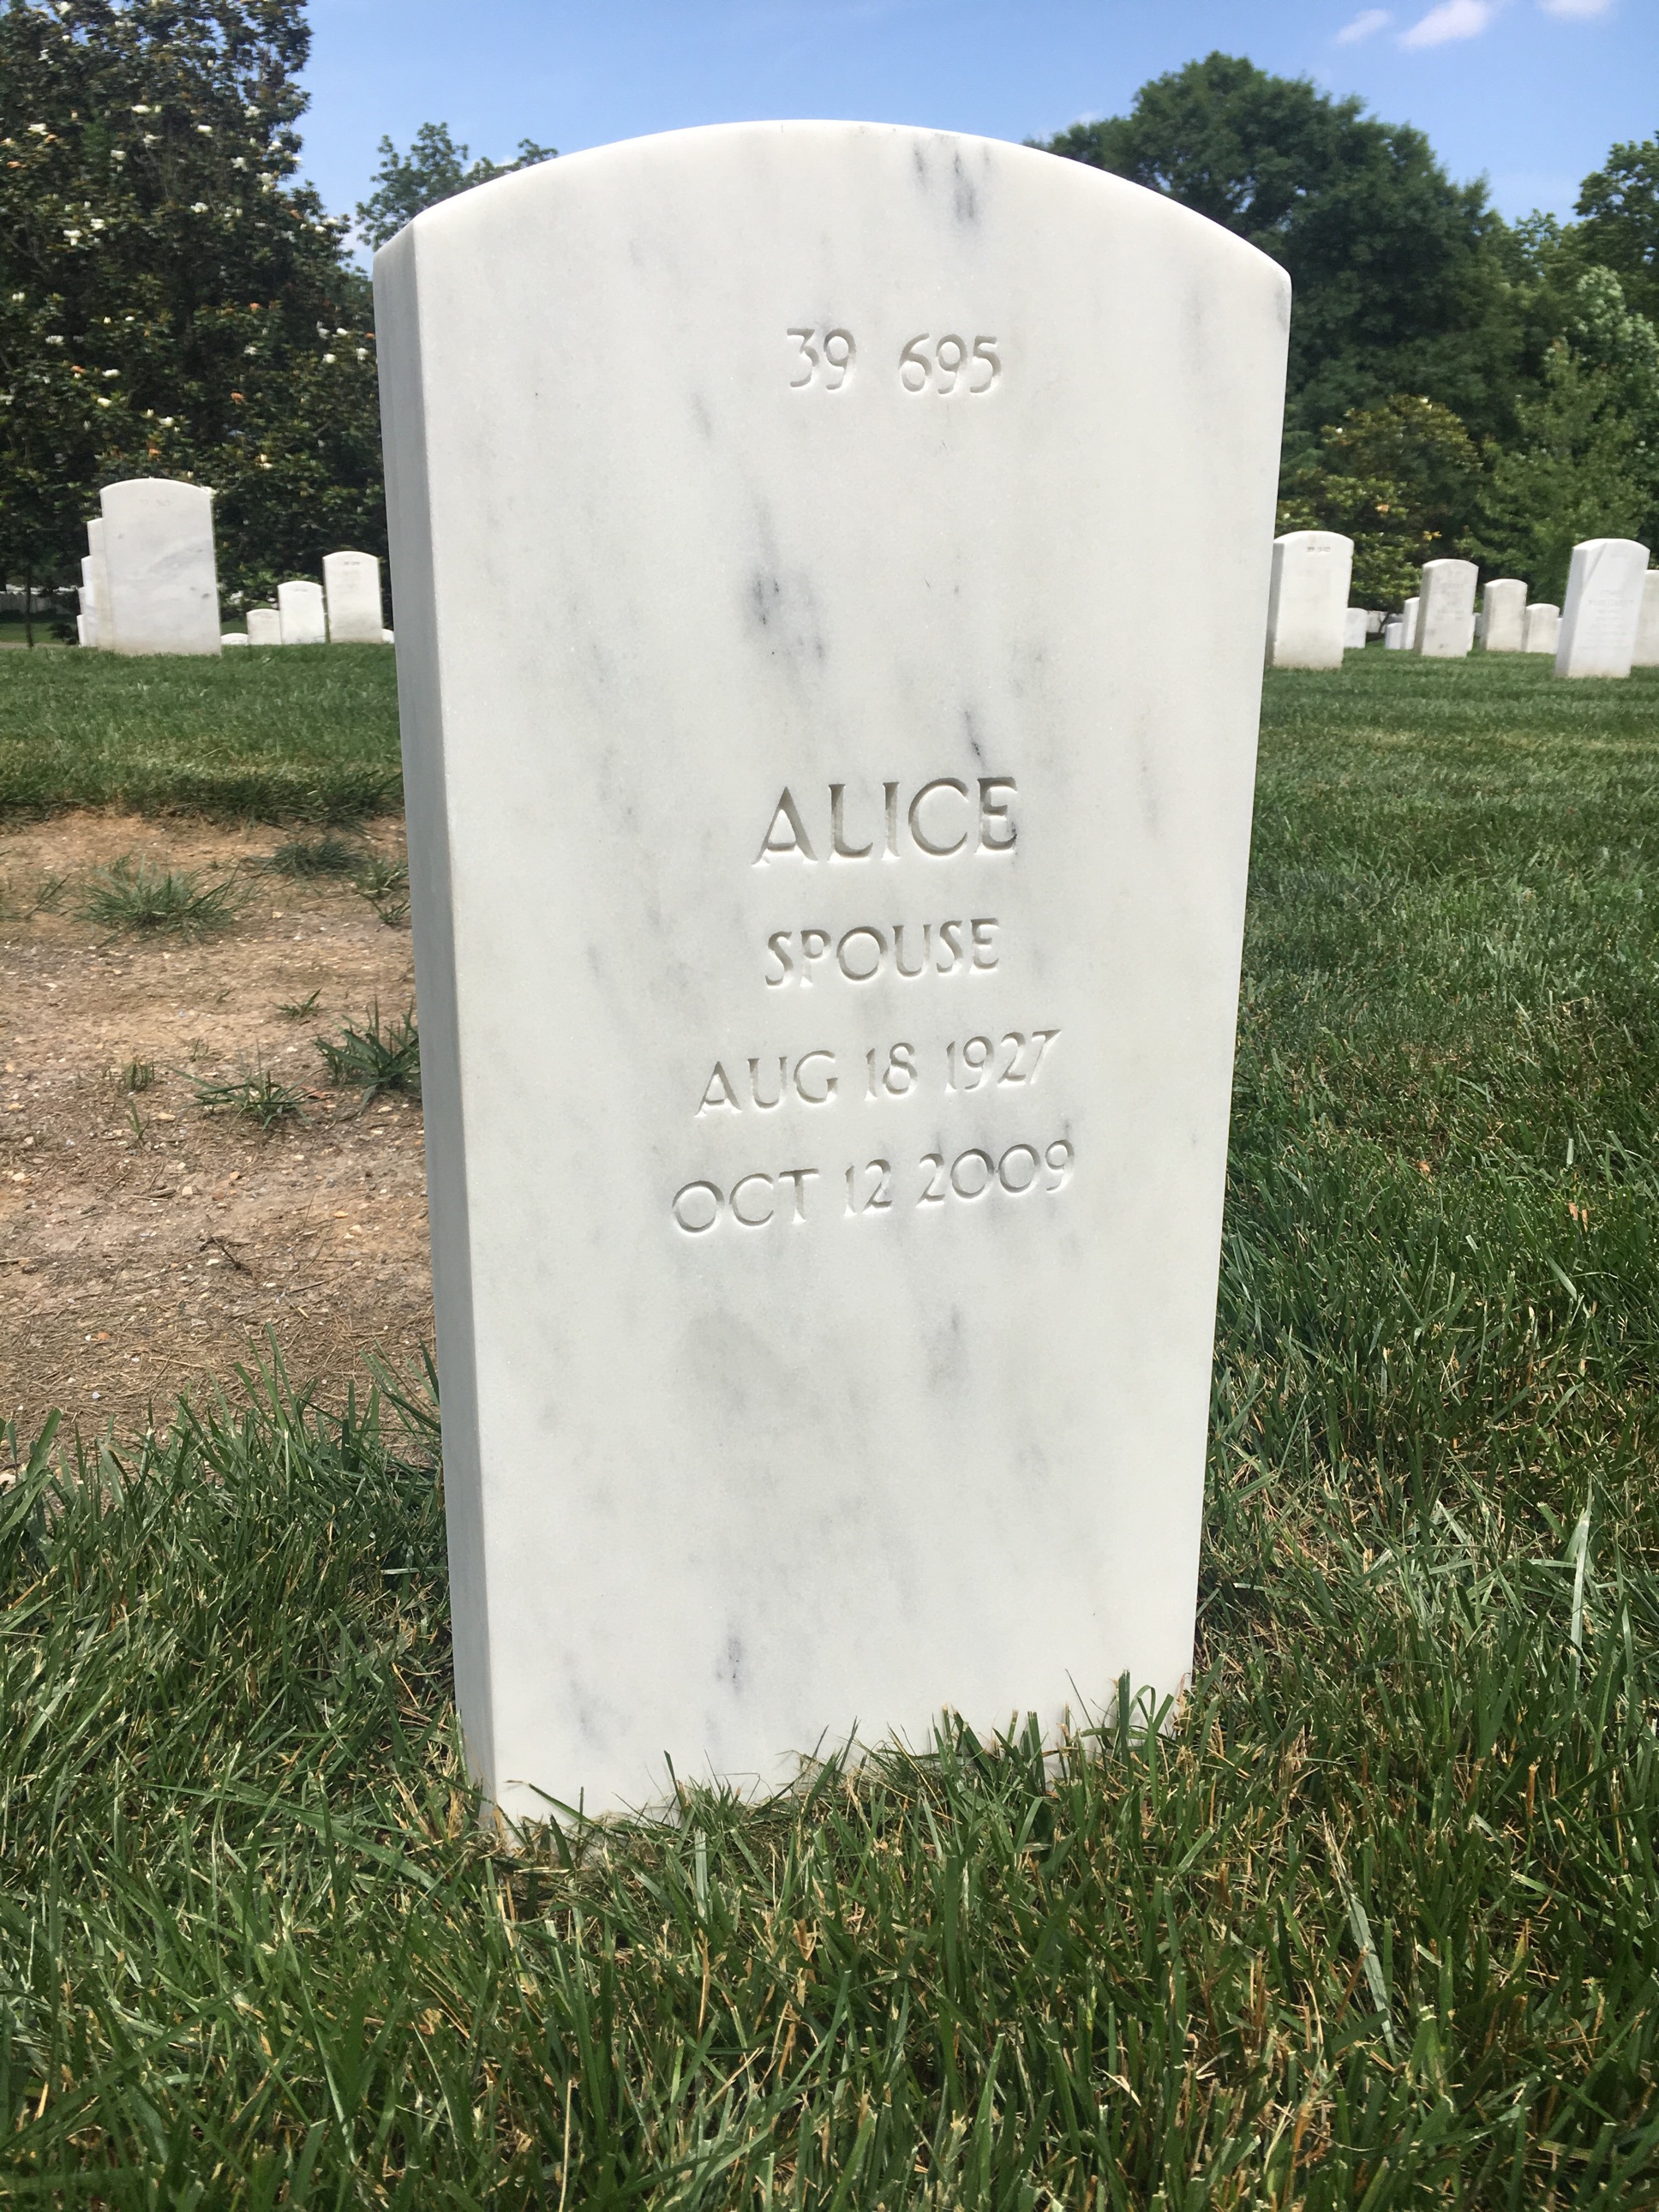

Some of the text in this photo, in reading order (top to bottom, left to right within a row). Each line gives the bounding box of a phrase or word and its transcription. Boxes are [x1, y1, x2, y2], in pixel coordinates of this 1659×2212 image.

[787, 327, 1002, 394] 39 695
[751, 776, 1018, 867] ALICE
[764, 917, 1000, 989] SPOUSE
[693, 1028, 1063, 1117] AUG 18 1927
[671, 1138, 1076, 1234] OCT 12 2009
